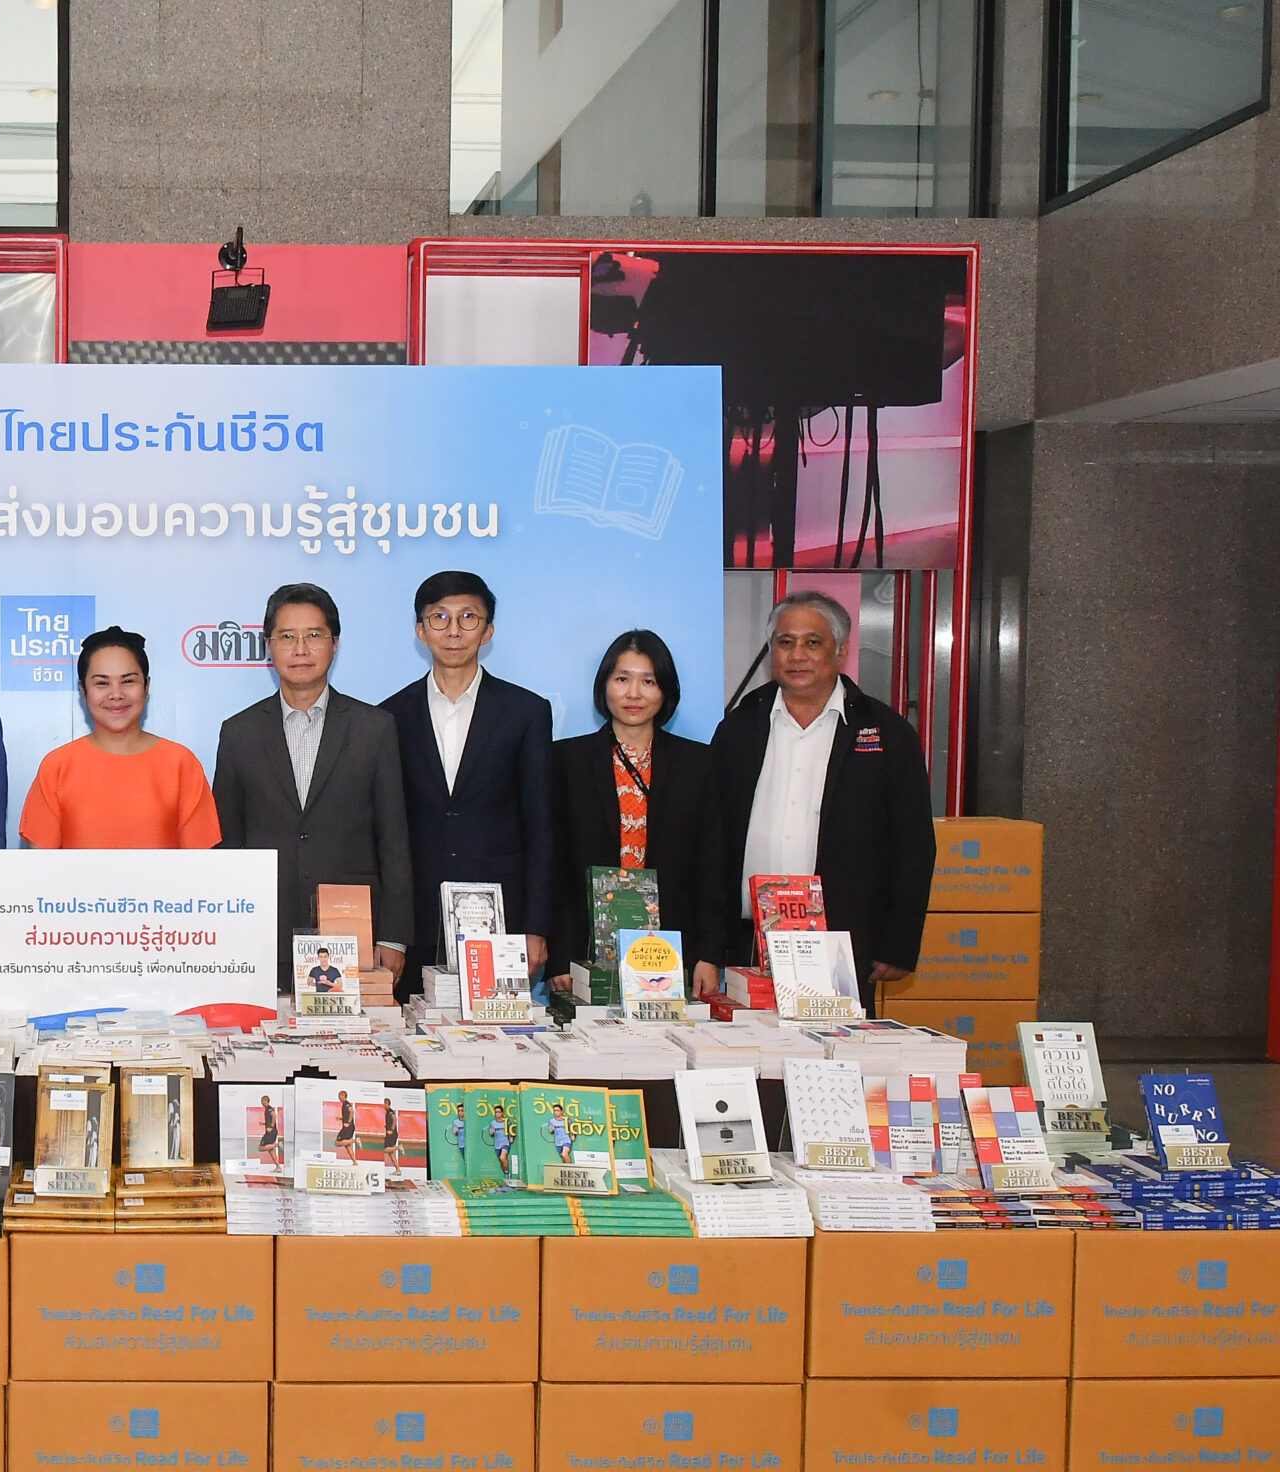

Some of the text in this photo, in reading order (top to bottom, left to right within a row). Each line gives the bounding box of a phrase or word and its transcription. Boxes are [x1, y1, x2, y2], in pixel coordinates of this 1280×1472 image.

[16, 607, 70, 633] ไทย
[193, 620, 272, 661] มติช
[33, 666, 64, 683] ชีวิต
[37, 896, 150, 914] ไทยประกันชีวิต
[153, 899, 194, 914] Read
[197, 899, 224, 914] For
[226, 899, 256, 914] Life
[779, 902, 807, 919] RED
[24, 926, 217, 953] ส่งมอบความรู้สู่ชุมชน
[67, 960, 144, 977] สร้างการเรียนรู้
[313, 996, 346, 1006] BEST
[484, 1001, 518, 1011] BEST
[638, 1002, 670, 1011] BEST
[809, 999, 840, 1009] BEST
[306, 1005, 353, 1015] SELLER
[477, 1010, 525, 1020] SELLER
[631, 1010, 679, 1020] SELLER
[802, 1007, 849, 1017] SELLER
[1152, 1083, 1176, 1096] NO
[1056, 1111, 1093, 1122] BEST
[1050, 1120, 1102, 1131] SELLER
[1196, 1128, 1219, 1143] NO
[825, 1146, 856, 1157] BEST
[1181, 1147, 1215, 1157] BEST
[718, 1157, 749, 1167] BEST
[817, 1156, 864, 1166] SELLER
[1175, 1156, 1224, 1166] SELLER
[322, 1169, 355, 1180] BEST
[559, 1169, 589, 1179] BEST
[713, 1166, 756, 1176] SELLER
[1007, 1167, 1040, 1178] BEST
[315, 1178, 363, 1190] SELLER
[553, 1177, 596, 1188] SELLER
[1001, 1176, 1049, 1187] SELLER
[141, 1305, 186, 1322] Read
[191, 1305, 220, 1322] For
[224, 1305, 257, 1322] Life
[407, 1305, 451, 1323] Read
[457, 1306, 486, 1323] For
[490, 1305, 522, 1323] Life
[942, 1300, 987, 1318] Read
[992, 1301, 1020, 1318] For
[1025, 1300, 1057, 1318] Life
[1202, 1301, 1280, 1319] Read For
[674, 1306, 789, 1325] Read For Life
[136, 1450, 250, 1467] Read For Life
[402, 1453, 516, 1471] Read For Life
[934, 1448, 1048, 1466] Read For Life
